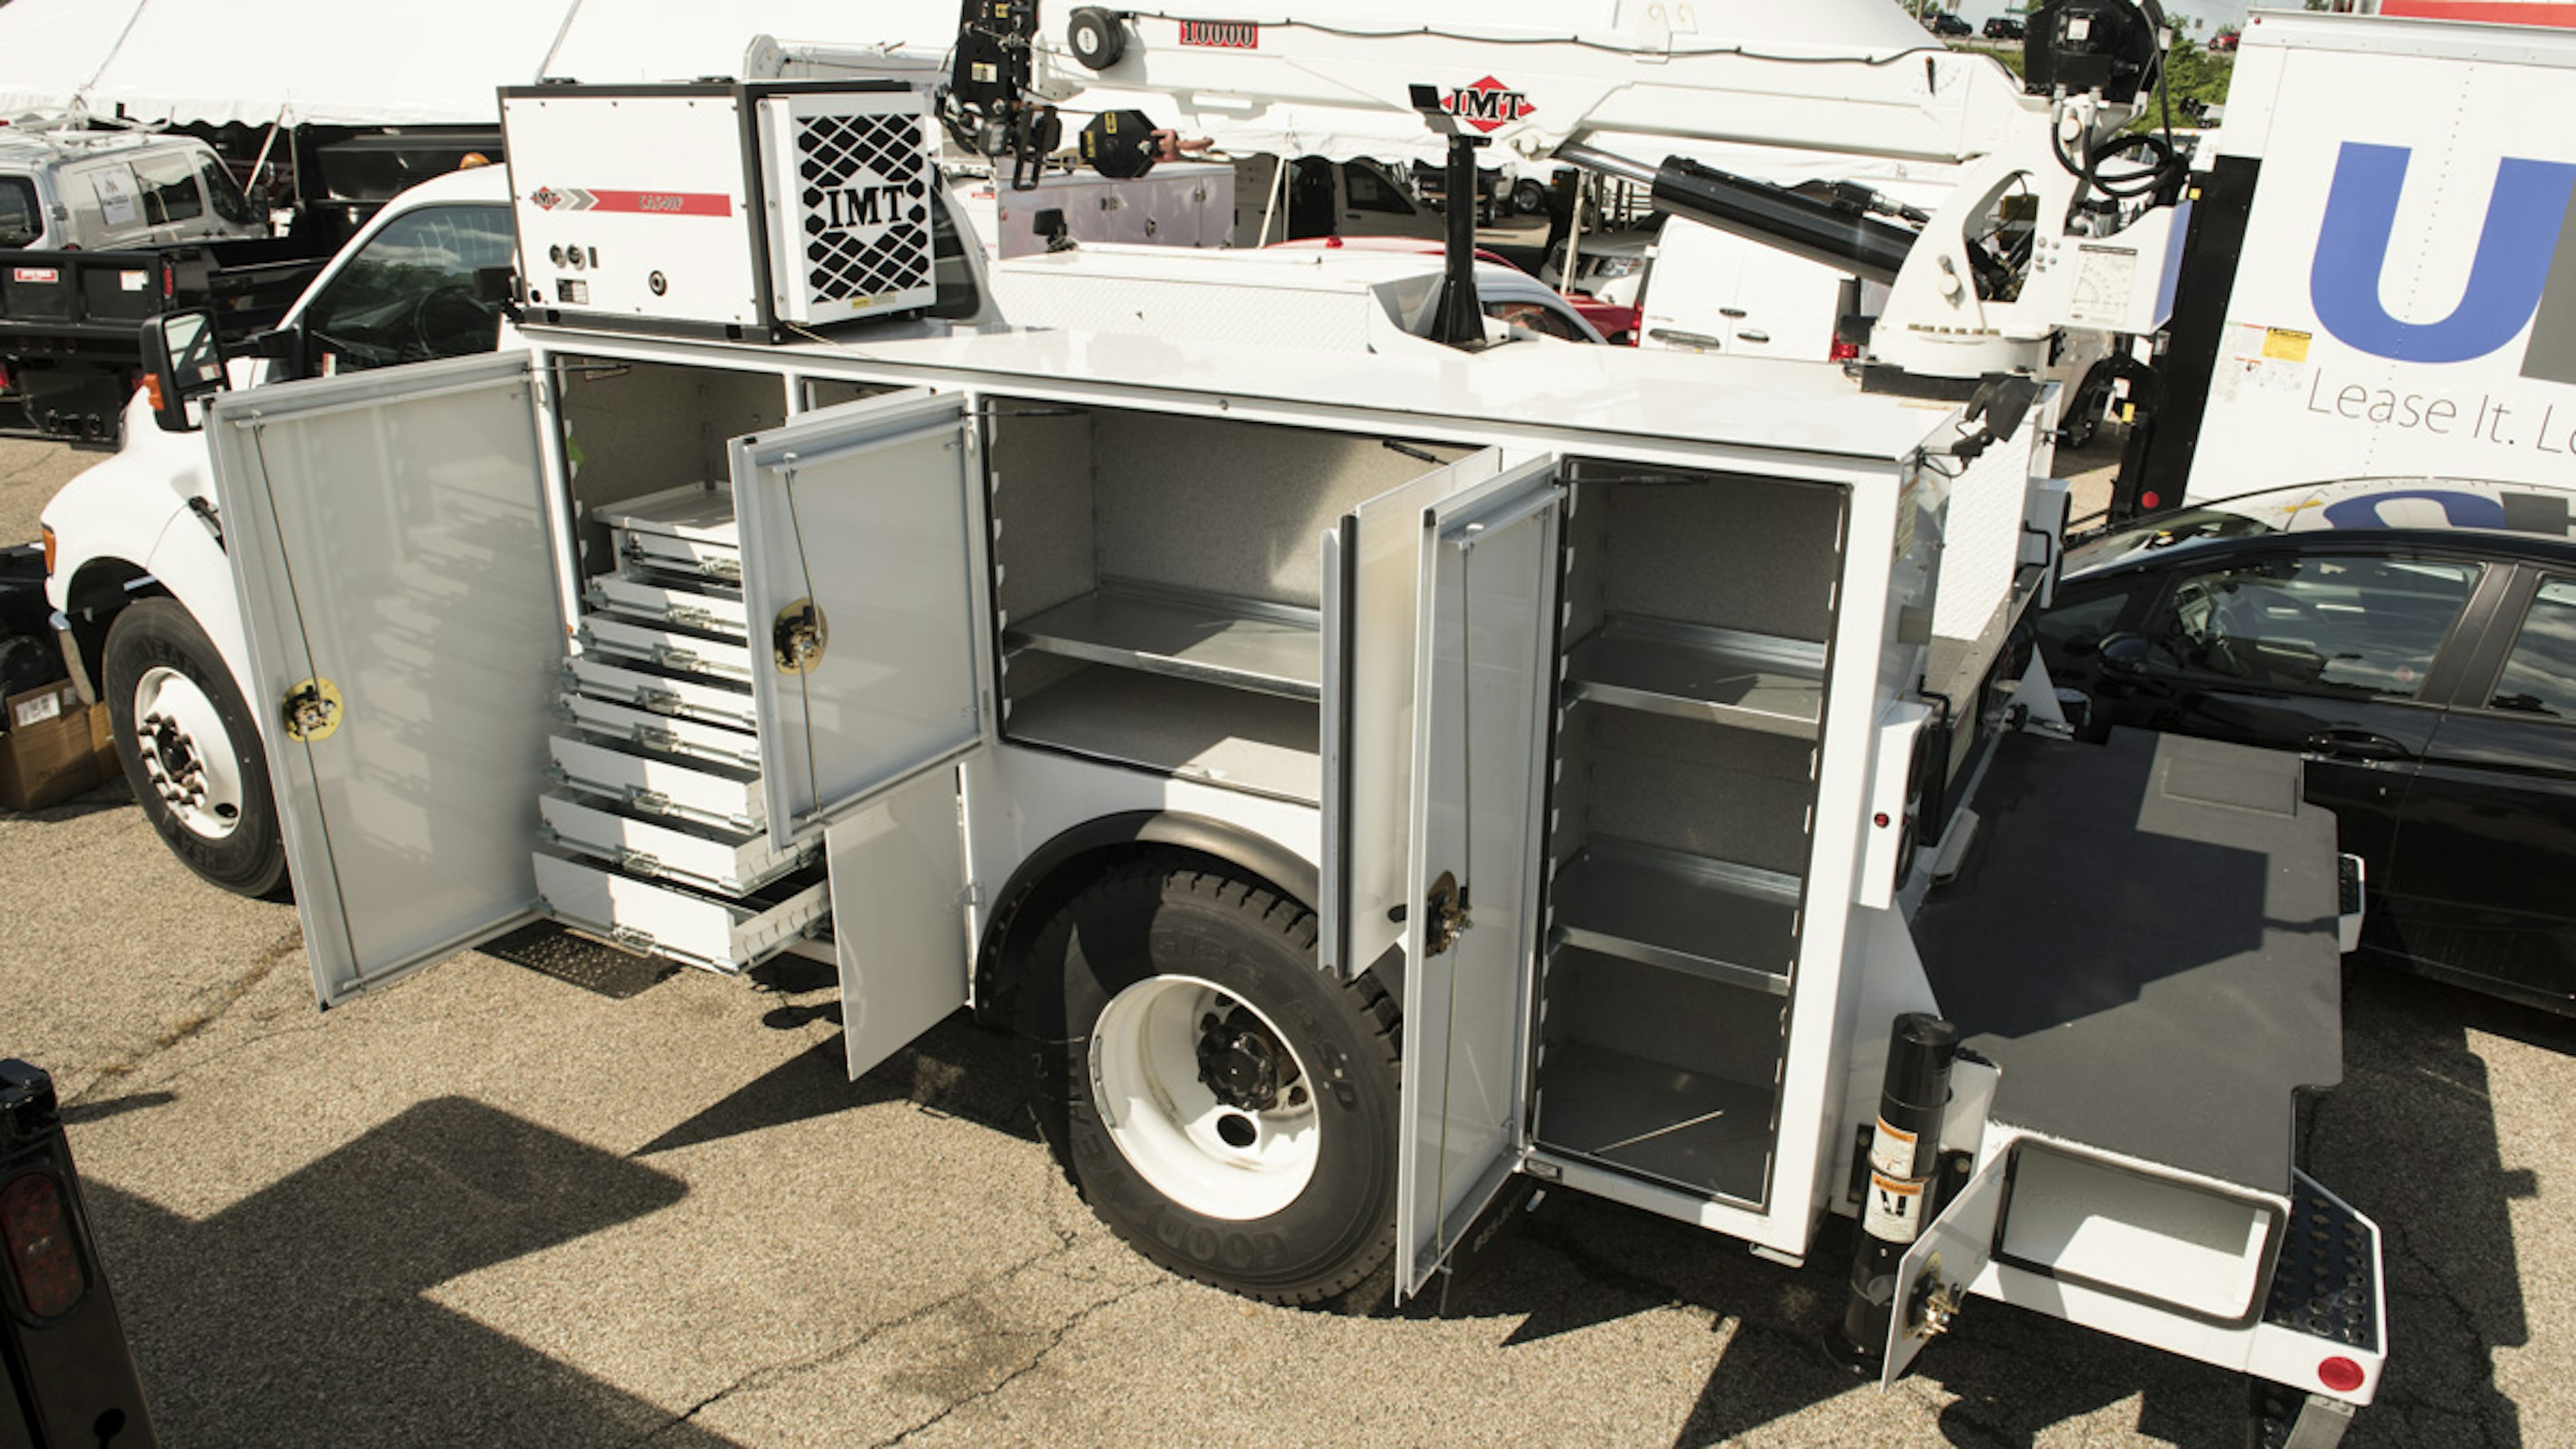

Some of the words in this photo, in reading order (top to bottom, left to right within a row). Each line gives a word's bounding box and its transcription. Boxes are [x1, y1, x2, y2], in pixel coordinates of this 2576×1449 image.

[1183, 21, 1254, 46] 10000
[1452, 87, 1525, 120] IMT
[826, 184, 905, 228] IMT
[2308, 367, 2457, 434] Lease
[2473, 394, 2515, 445] It.
[2536, 404, 2576, 455] L
